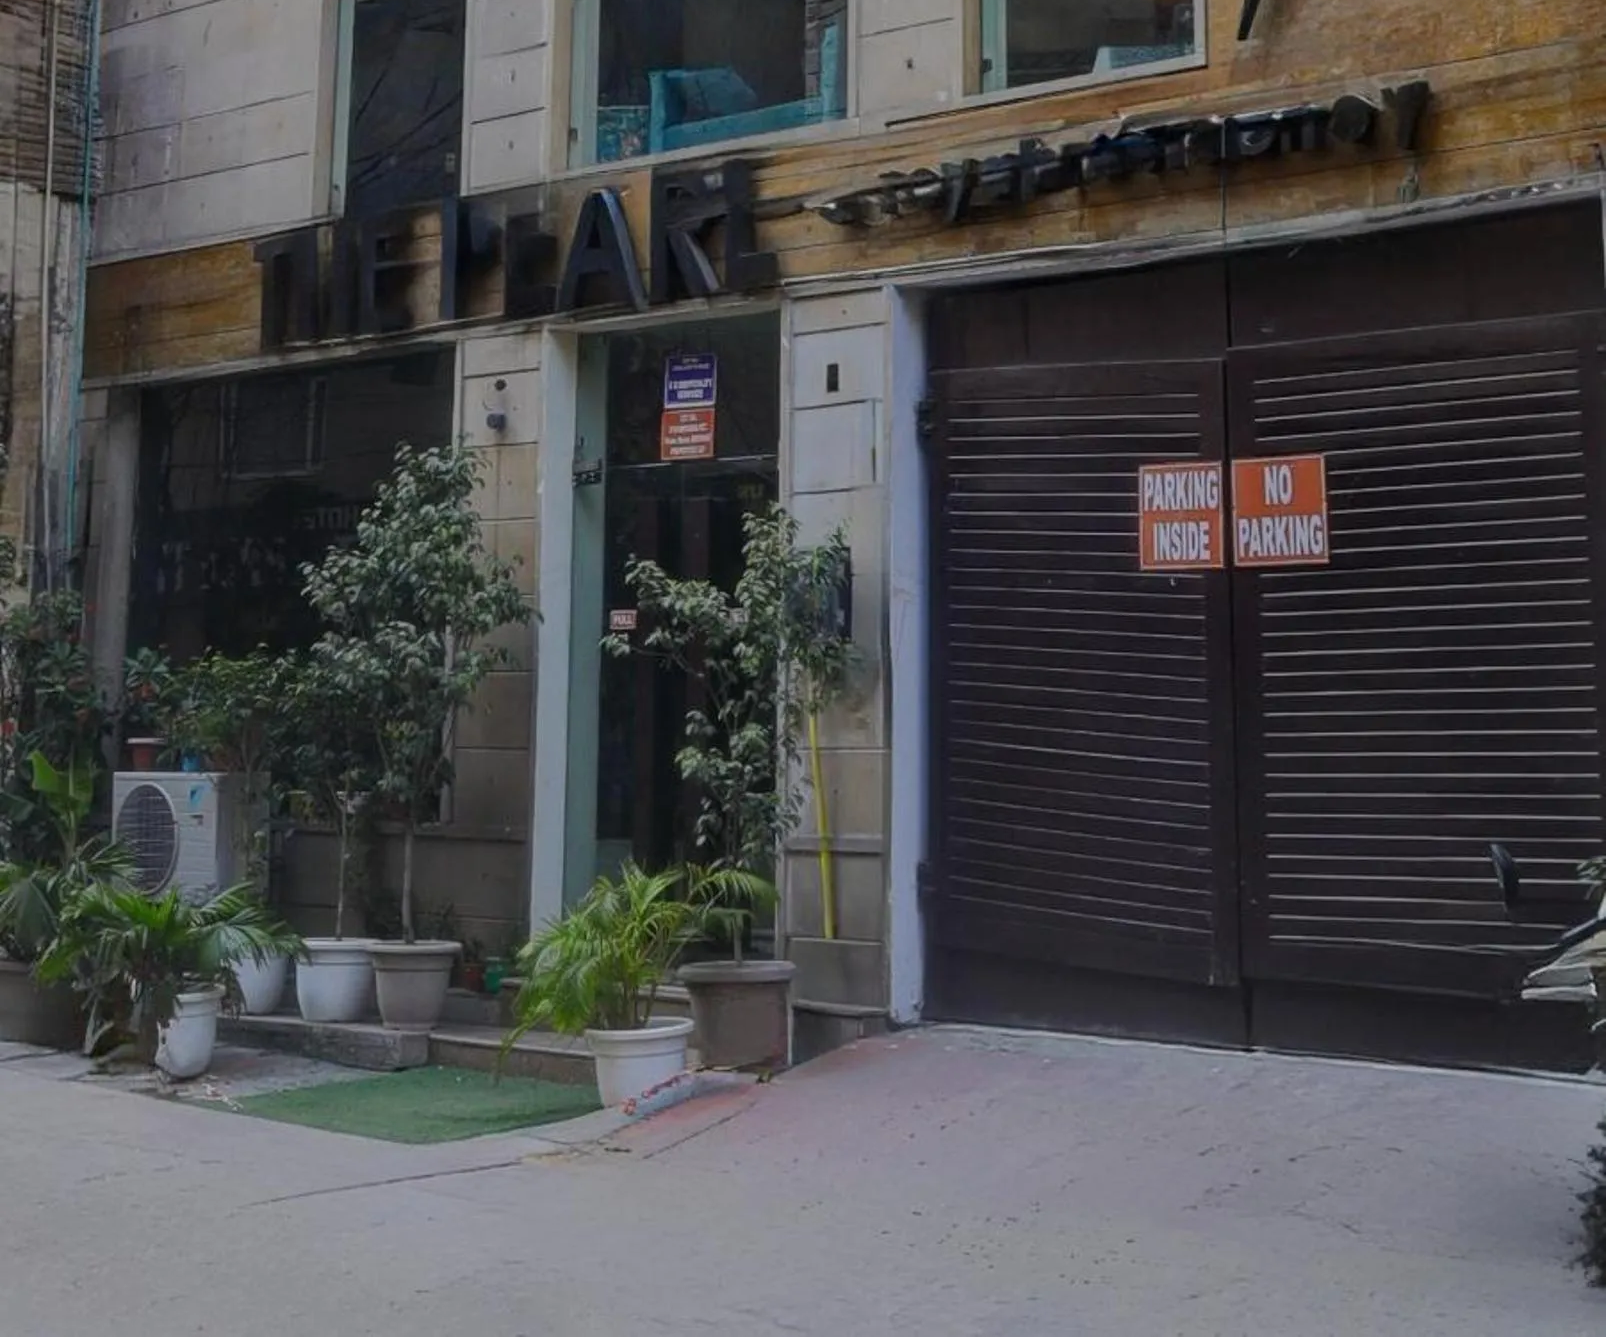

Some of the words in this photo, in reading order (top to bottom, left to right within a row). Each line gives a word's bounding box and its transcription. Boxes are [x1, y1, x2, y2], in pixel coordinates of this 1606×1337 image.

[1143, 470, 1219, 512] PARKING
[1264, 464, 1293, 506] NO
[1153, 521, 1211, 561] INSIDE
[1238, 515, 1323, 558] PARKING
